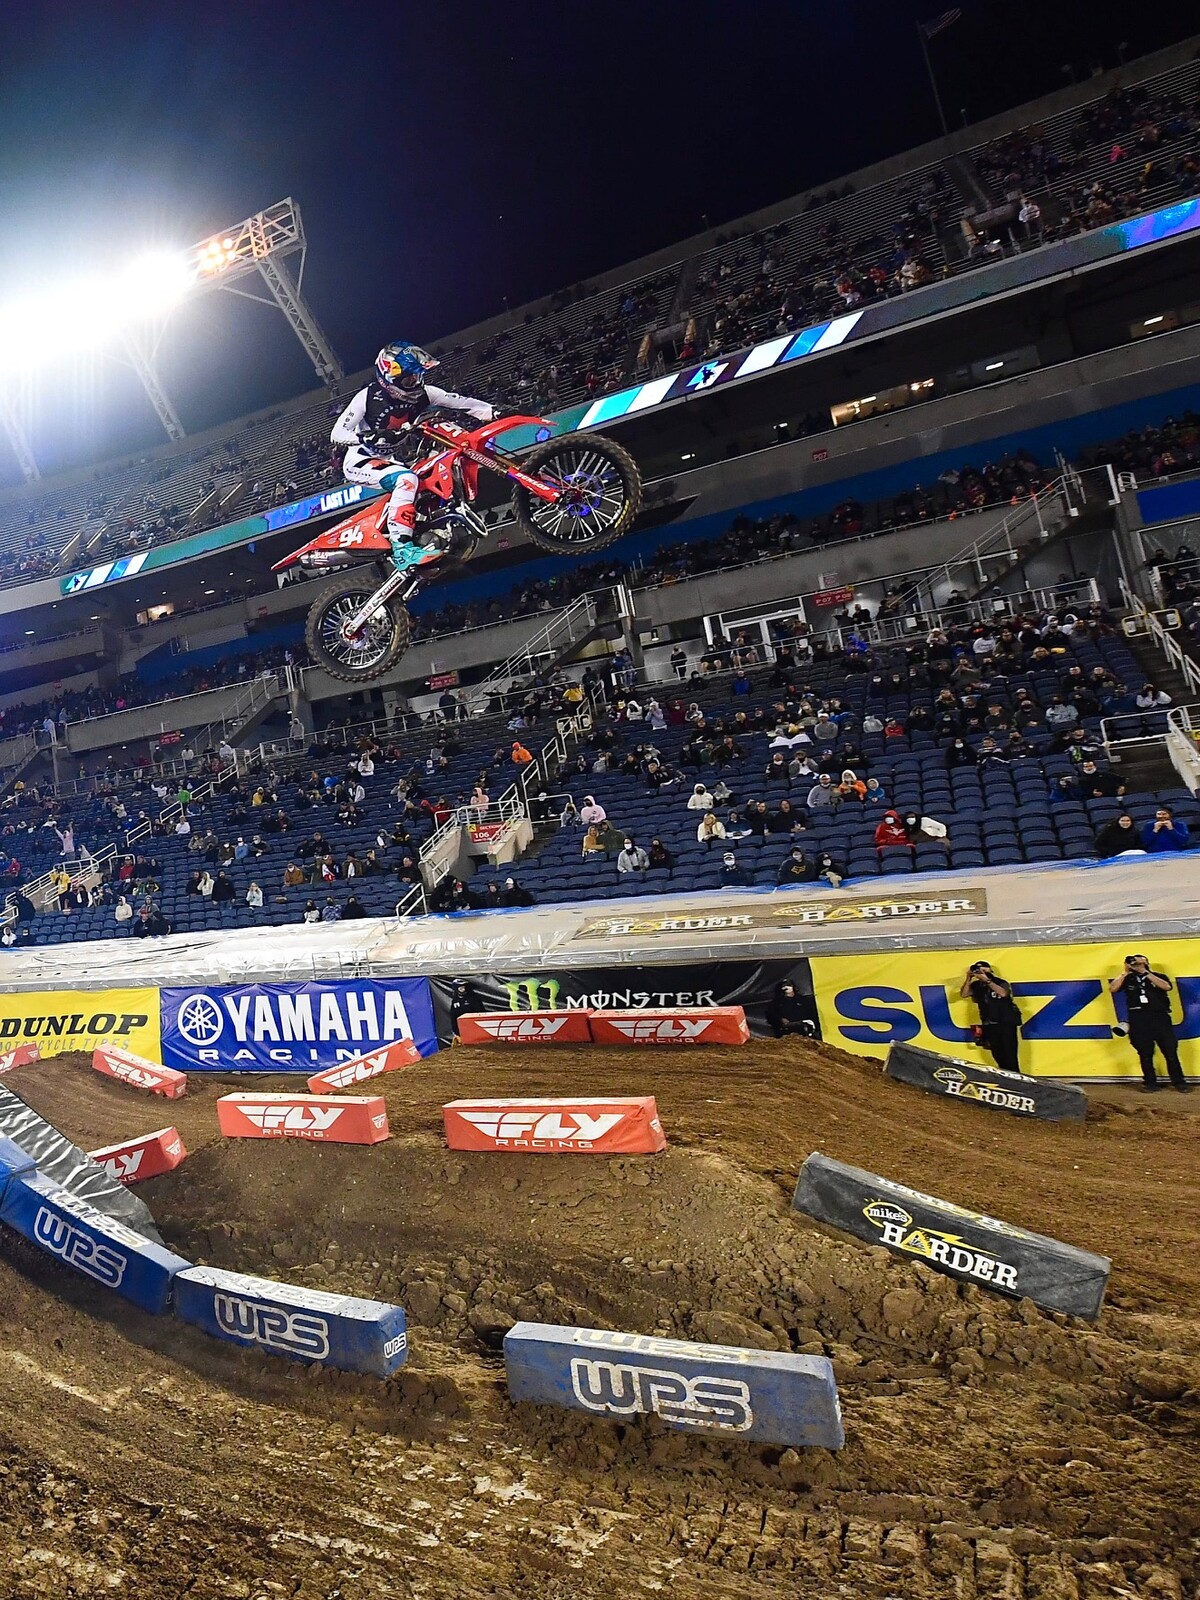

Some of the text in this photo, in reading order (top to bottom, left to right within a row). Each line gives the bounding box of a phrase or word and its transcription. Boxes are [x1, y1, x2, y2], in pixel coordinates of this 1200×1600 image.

[321, 485, 363, 511] LAST LAP
[338, 524, 364, 548] 94
[474, 831, 490, 839] 106
[799, 899, 976, 923] HARDER
[607, 914, 754, 936] HARDER
[566, 988, 719, 1010] MONSTER
[223, 989, 414, 1042] YAMAHA
[474, 1017, 569, 1037] FLY
[607, 1020, 715, 1037] FLY
[632, 1036, 695, 1044] RACING
[198, 1049, 362, 1062] RACIN
[102, 1055, 164, 1088] FLY
[320, 1051, 390, 1088] FLY
[944, 1079, 1036, 1114] HARDER
[236, 1106, 345, 1129] FLY
[456, 1111, 626, 1140] FLY
[262, 1128, 325, 1138] RACING
[495, 1138, 594, 1149] RACING
[868, 1207, 909, 1223] mike's
[34, 1206, 128, 1288] WPS
[879, 1220, 1019, 1290] HARDER
[214, 1293, 330, 1361] WPS
[384, 1332, 407, 1359] WPS
[570, 1357, 753, 1432] WPS
